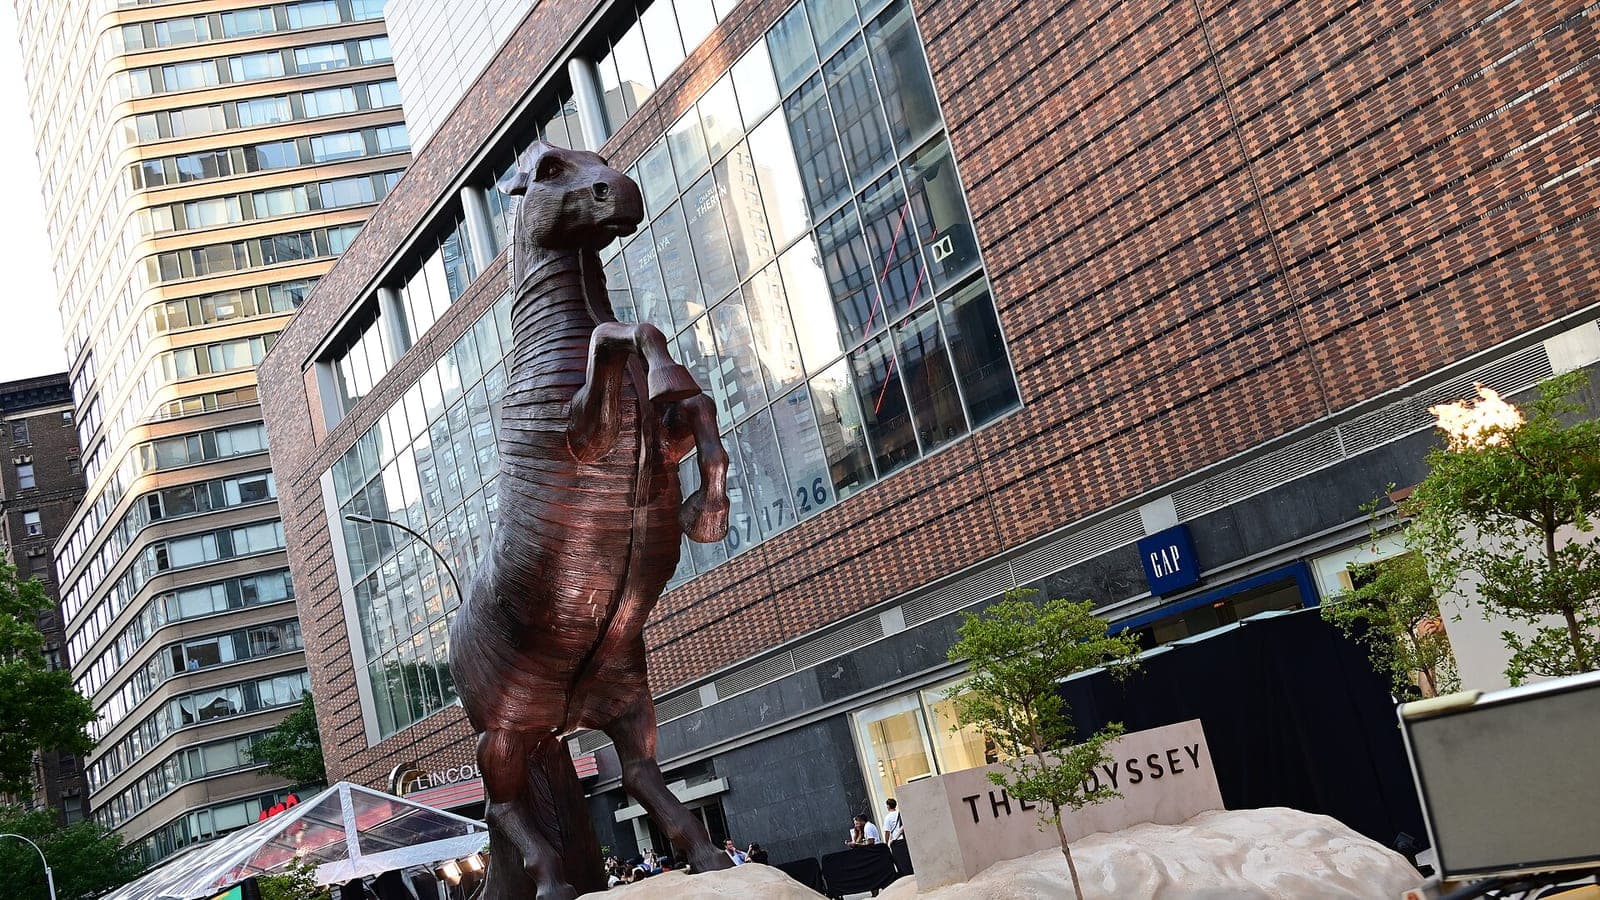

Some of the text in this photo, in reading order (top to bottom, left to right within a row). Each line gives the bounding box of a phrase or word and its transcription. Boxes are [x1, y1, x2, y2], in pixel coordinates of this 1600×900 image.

[1150, 545, 1180, 578] GAP
[416, 763, 482, 790] LINCOL
[1082, 743, 1200, 794] DYSSEY
